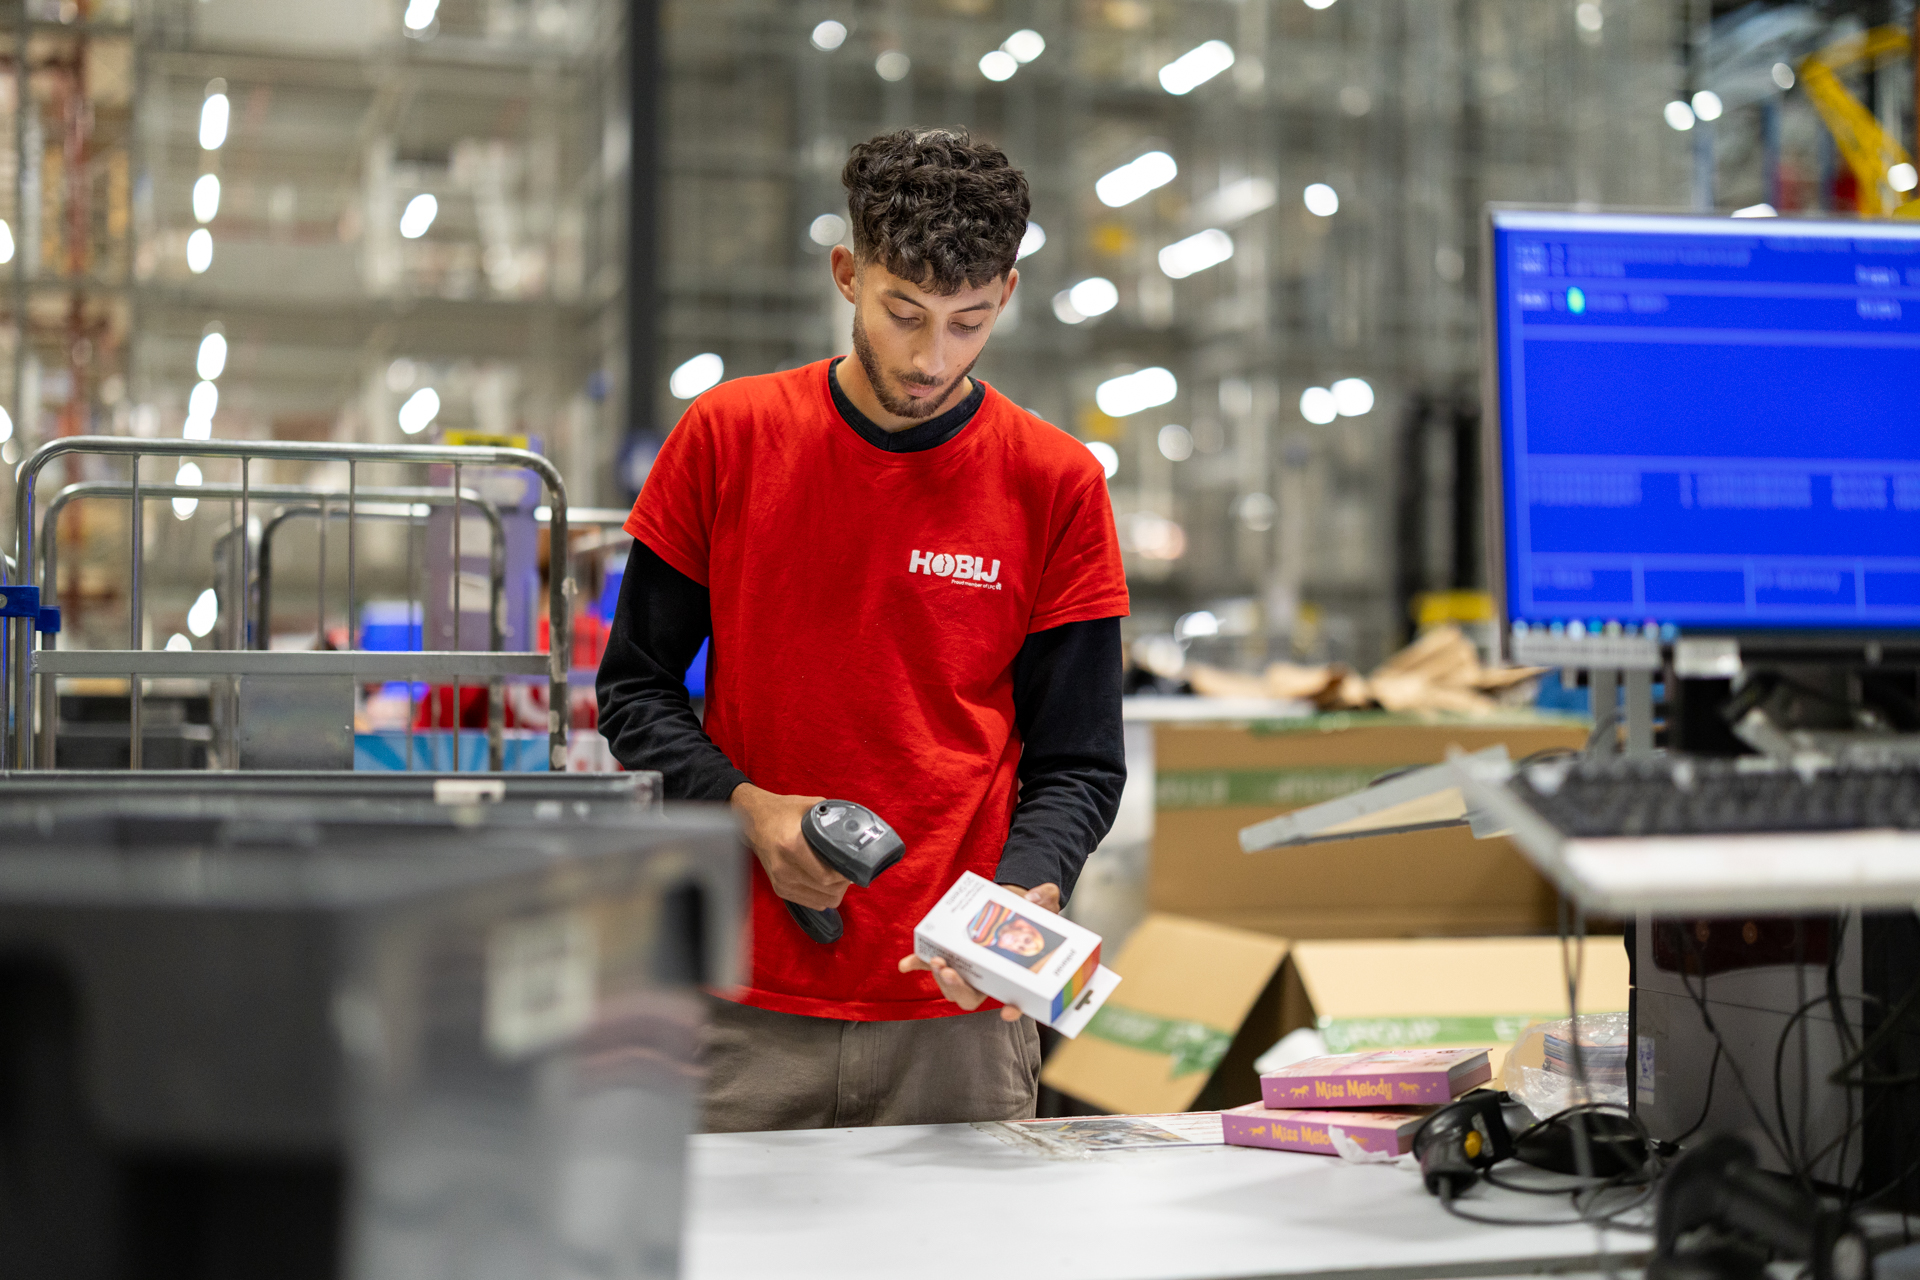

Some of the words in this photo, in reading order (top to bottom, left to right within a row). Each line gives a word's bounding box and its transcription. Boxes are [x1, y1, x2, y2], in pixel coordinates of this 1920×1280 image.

[909, 550, 1001, 583] HOBIJ
[1315, 1080, 1344, 1100] Miss
[1347, 1078, 1393, 1101] Melody
[1271, 1123, 1299, 1143] Miss
[1301, 1125, 1332, 1146] Melo
